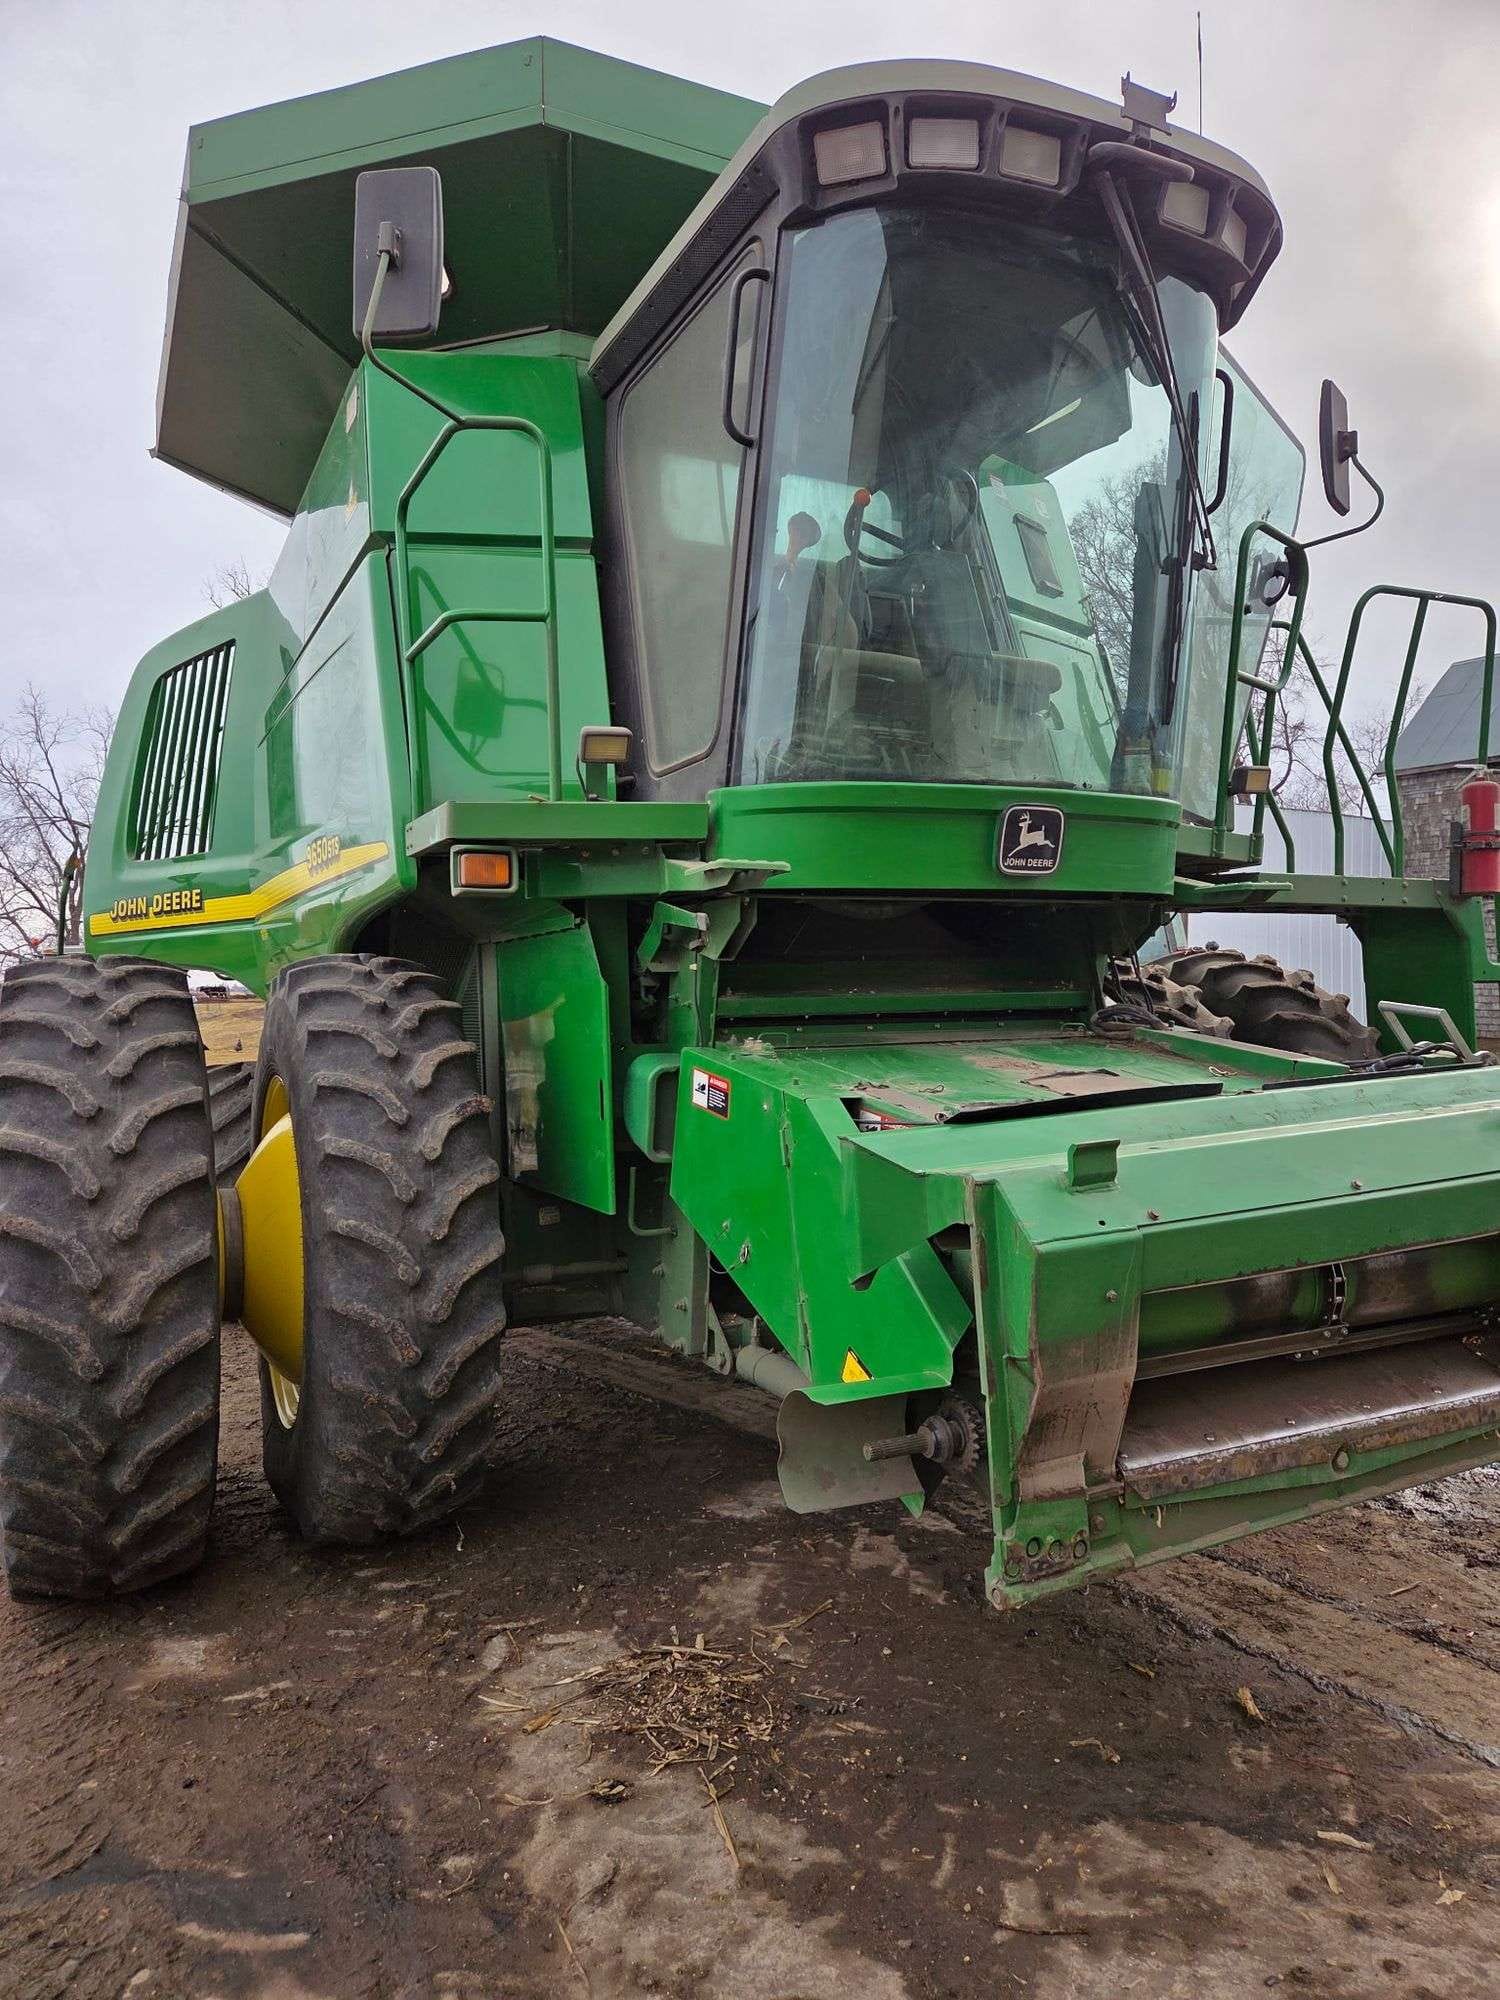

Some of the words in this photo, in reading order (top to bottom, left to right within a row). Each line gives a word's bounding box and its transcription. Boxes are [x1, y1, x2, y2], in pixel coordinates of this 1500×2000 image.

[1004, 857, 1026, 867] JOHN
[1027, 858, 1054, 868] DEERE
[110, 896, 147, 920] JOHN
[152, 888, 202, 914] DEERE
